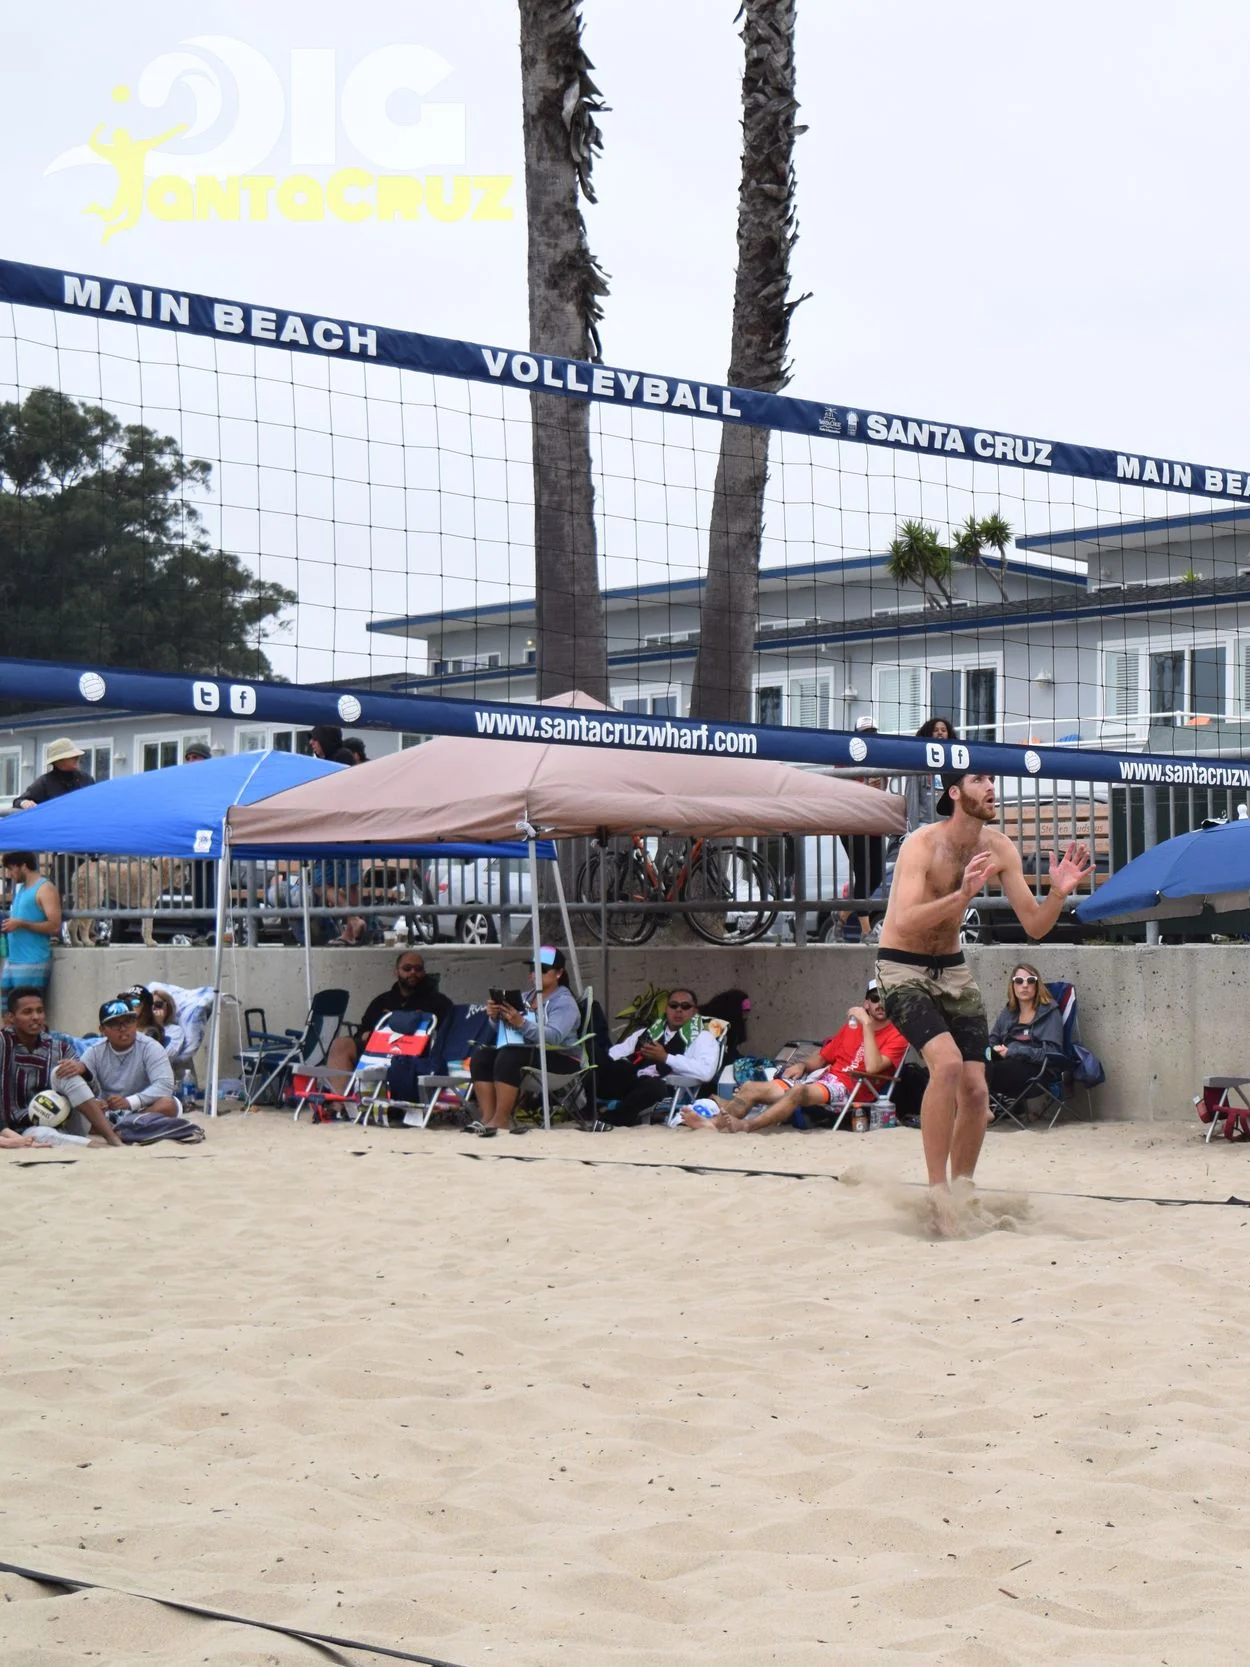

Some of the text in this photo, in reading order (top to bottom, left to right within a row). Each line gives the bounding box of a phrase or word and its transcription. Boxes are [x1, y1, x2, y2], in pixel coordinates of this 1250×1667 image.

[64, 276, 376, 356] MAIN BEACH
[482, 349, 740, 416] VOLLEYBALL
[867, 415, 965, 452] SANTA
[974, 433, 1052, 466] CRUZ
[1117, 455, 1191, 487] MAIN
[475, 711, 757, 754] www.santacruzwharf.com
